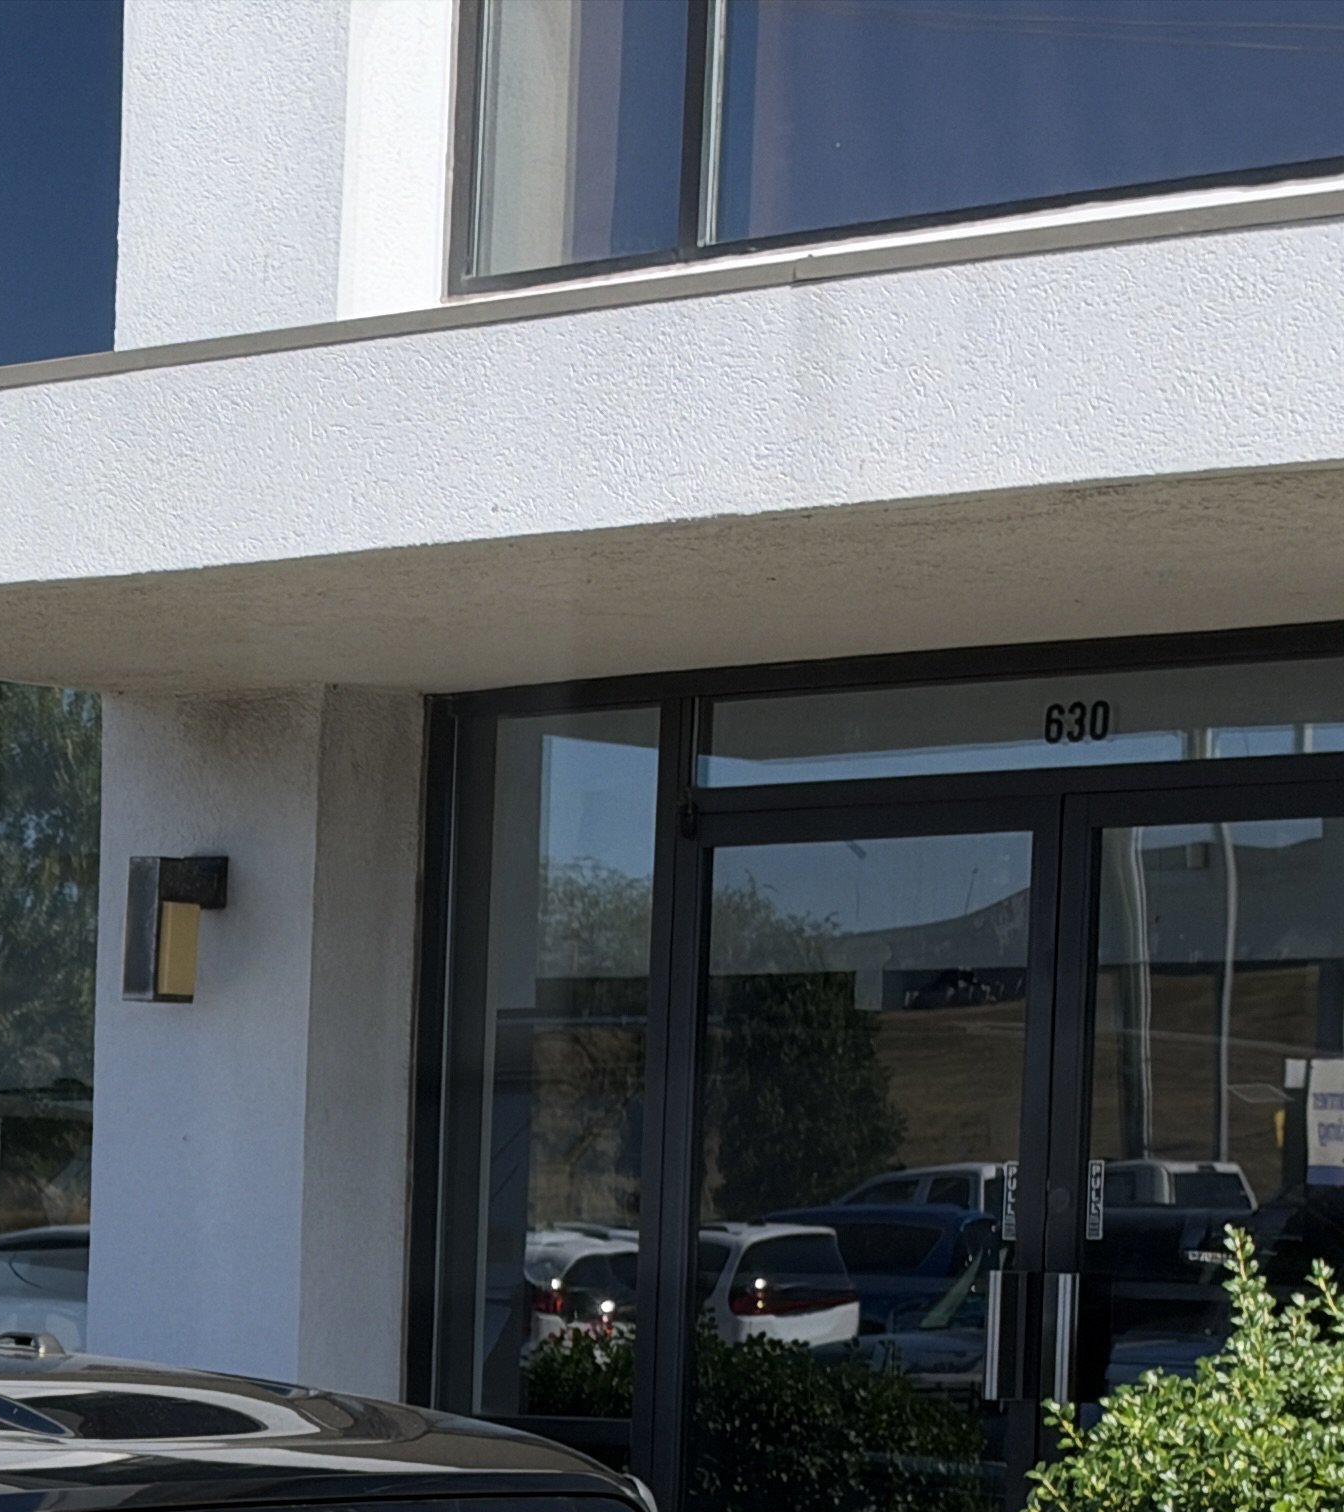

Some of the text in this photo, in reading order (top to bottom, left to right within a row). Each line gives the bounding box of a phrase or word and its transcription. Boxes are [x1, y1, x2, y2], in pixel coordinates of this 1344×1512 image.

[1044, 700, 1110, 744] 630
[1007, 1166, 1018, 1215] PULL
[1091, 1165, 1102, 1215] PULL
